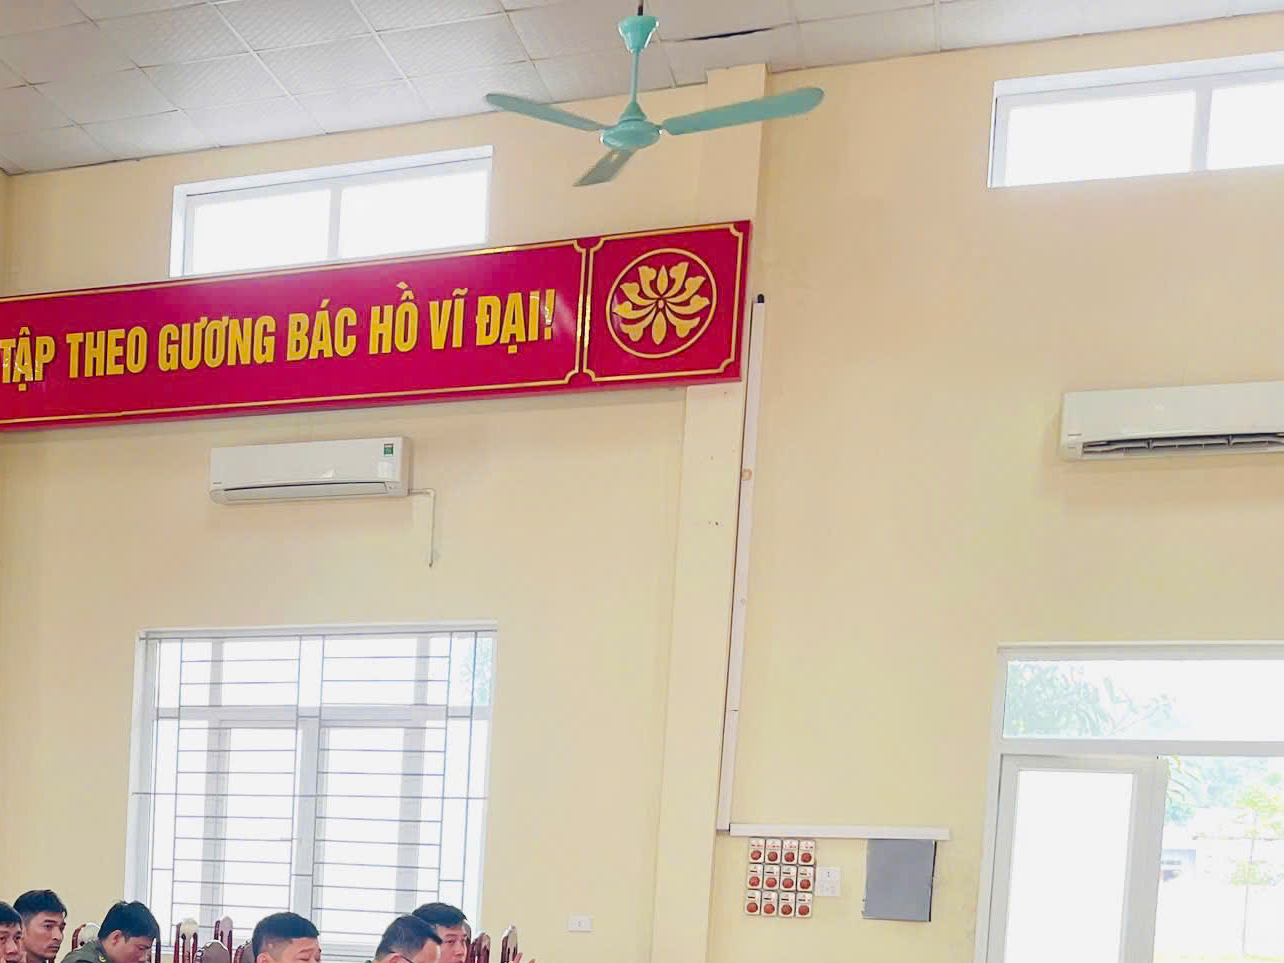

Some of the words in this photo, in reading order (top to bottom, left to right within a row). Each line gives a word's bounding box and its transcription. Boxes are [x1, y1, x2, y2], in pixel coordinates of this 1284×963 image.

[0, 327, 55, 391] TẬP
[66, 328, 148, 379] THEO
[158, 315, 276, 372] GƯƠNG
[286, 299, 357, 362] BÁC
[368, 281, 419, 355] HỒ
[429, 287, 468, 350] VĨ
[475, 289, 555, 354] ĐẠI!
